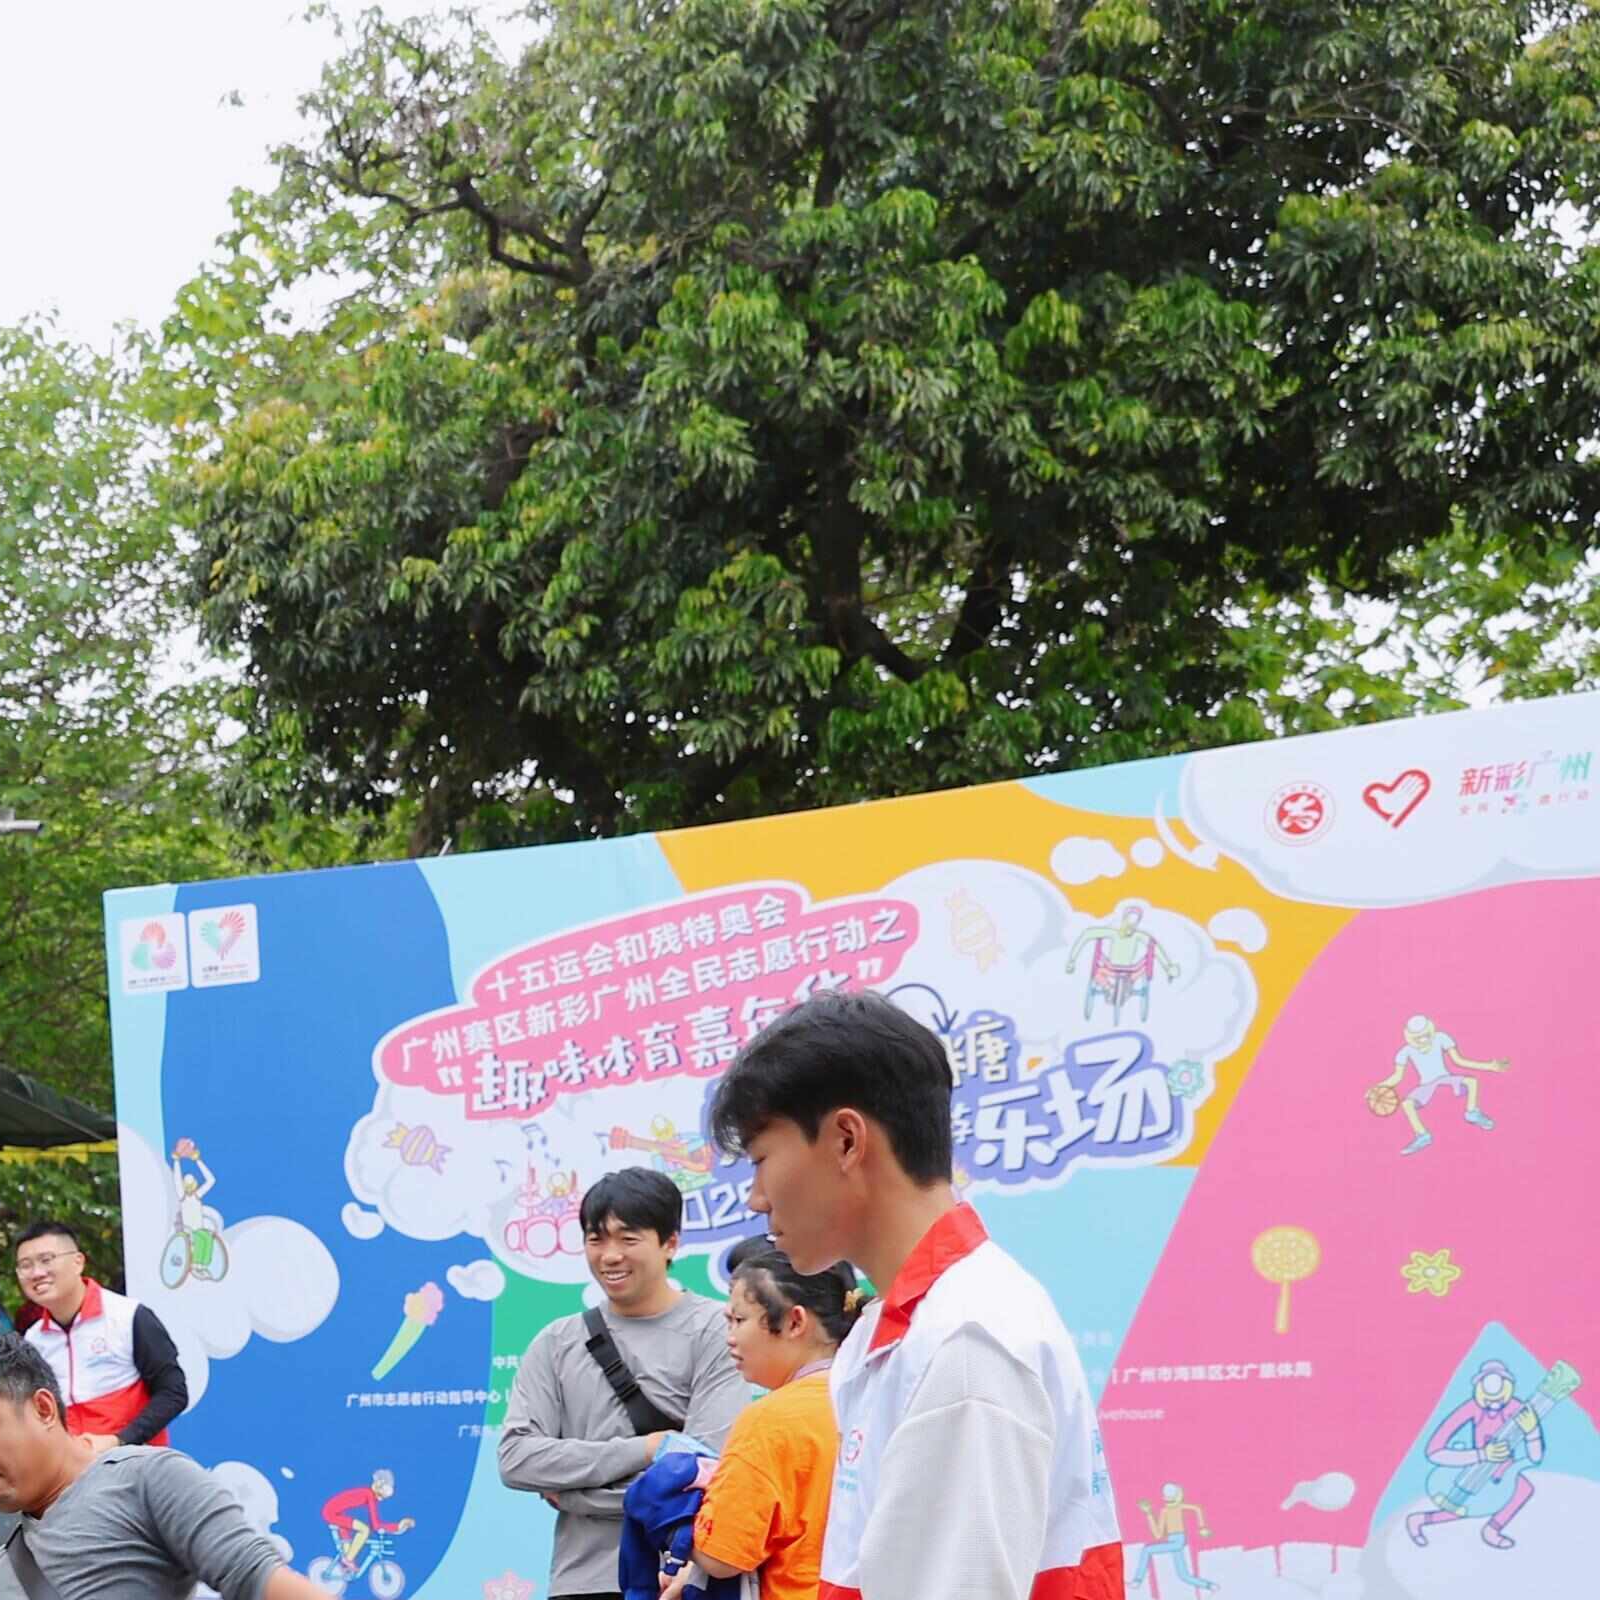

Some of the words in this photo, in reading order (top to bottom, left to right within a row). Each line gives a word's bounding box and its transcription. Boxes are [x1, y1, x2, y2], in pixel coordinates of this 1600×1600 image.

[401, 908, 906, 1072] 广州赛区新彩广州全民志愿行动之
[485, 893, 787, 1002] 十五运会和残特奥会
